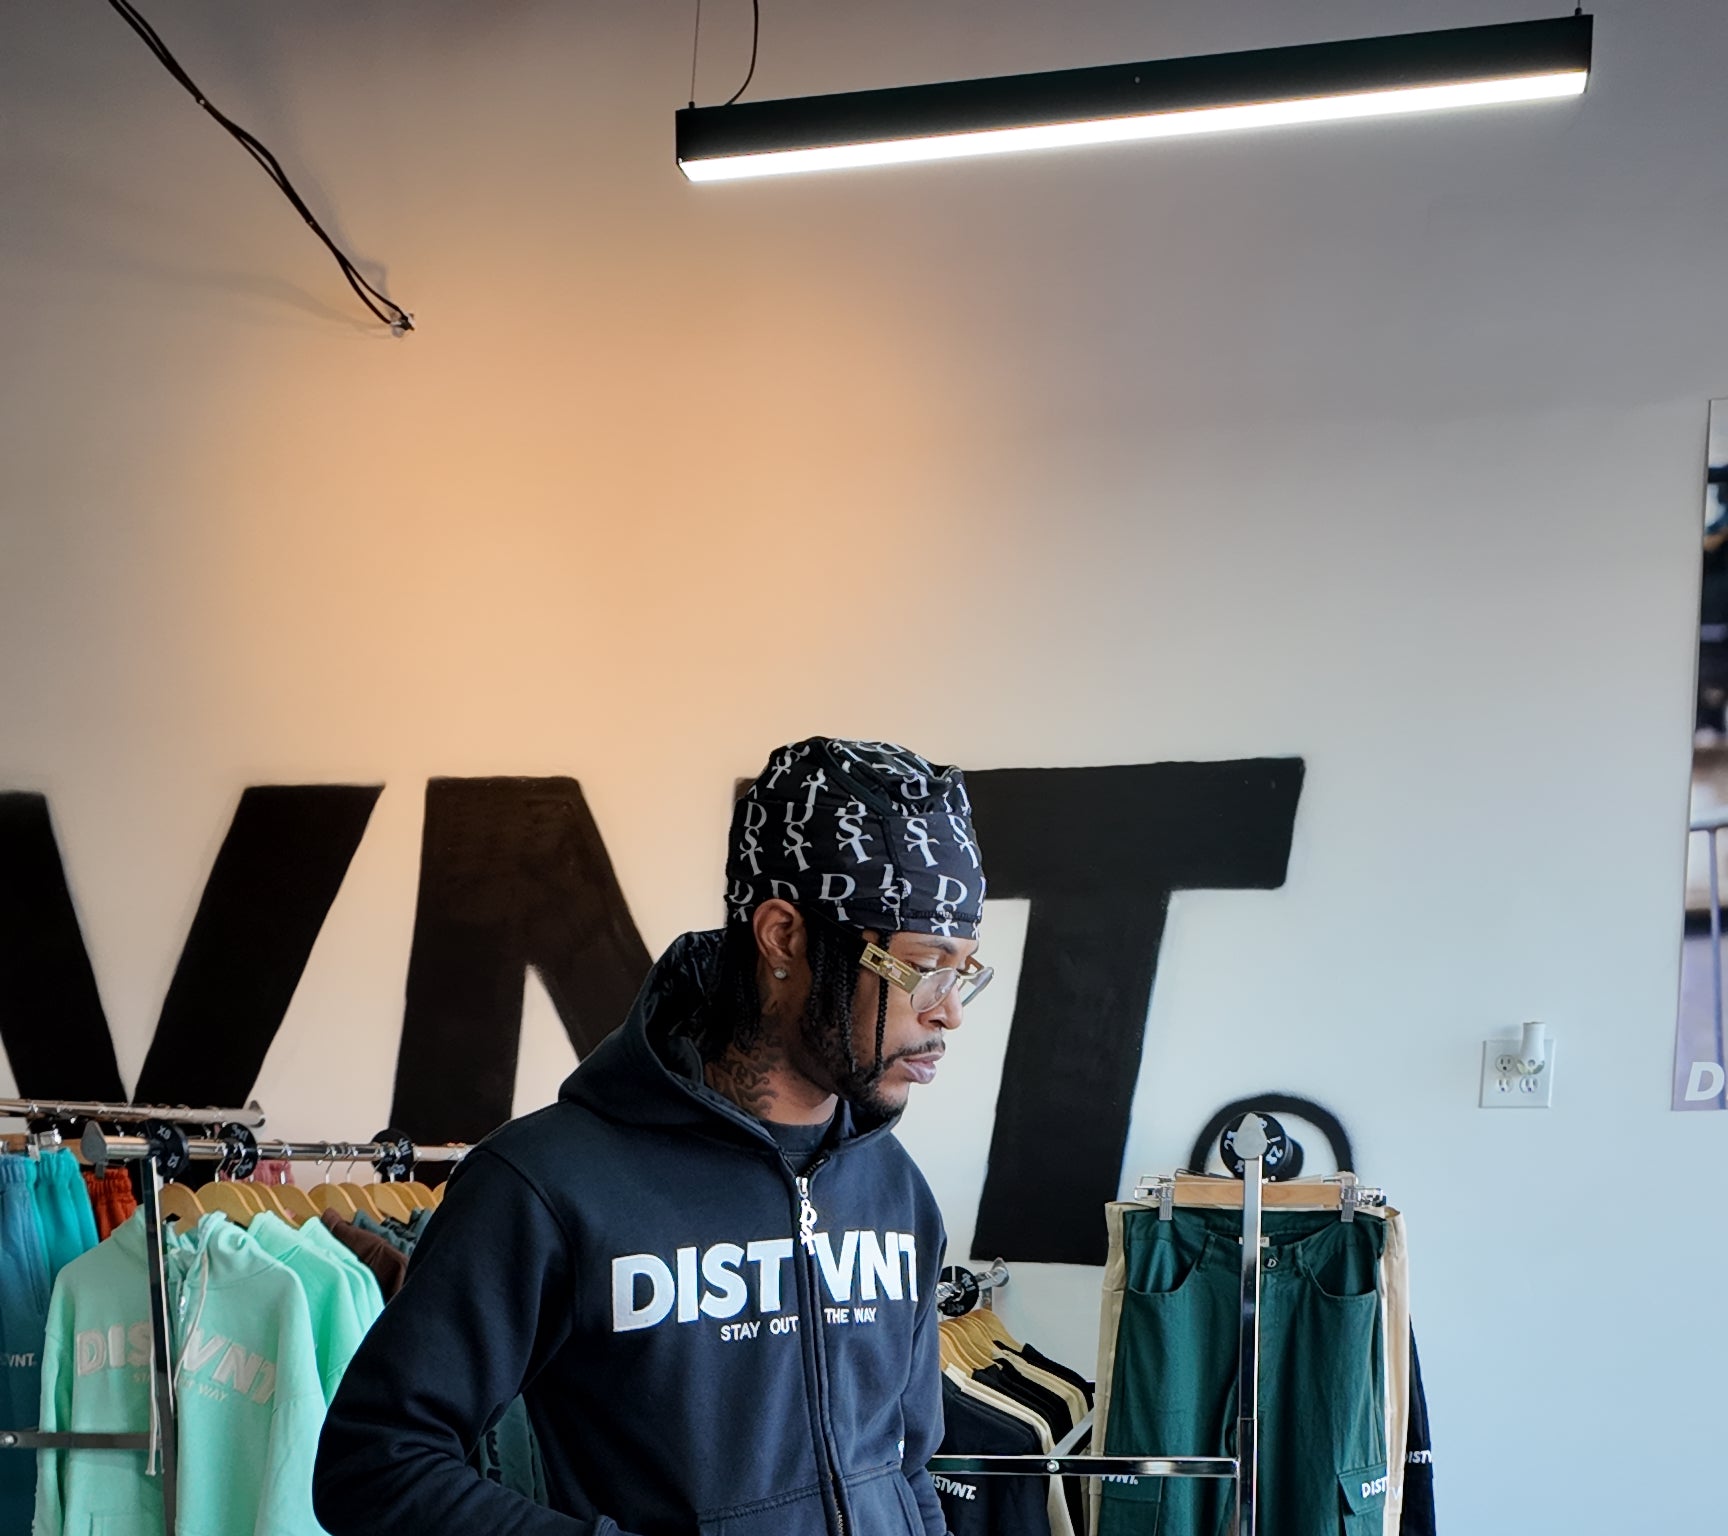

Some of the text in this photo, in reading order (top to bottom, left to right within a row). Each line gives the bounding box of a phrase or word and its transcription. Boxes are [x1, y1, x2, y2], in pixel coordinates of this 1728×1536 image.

[720, 1307, 877, 1341] STAY OUT THE WAY
